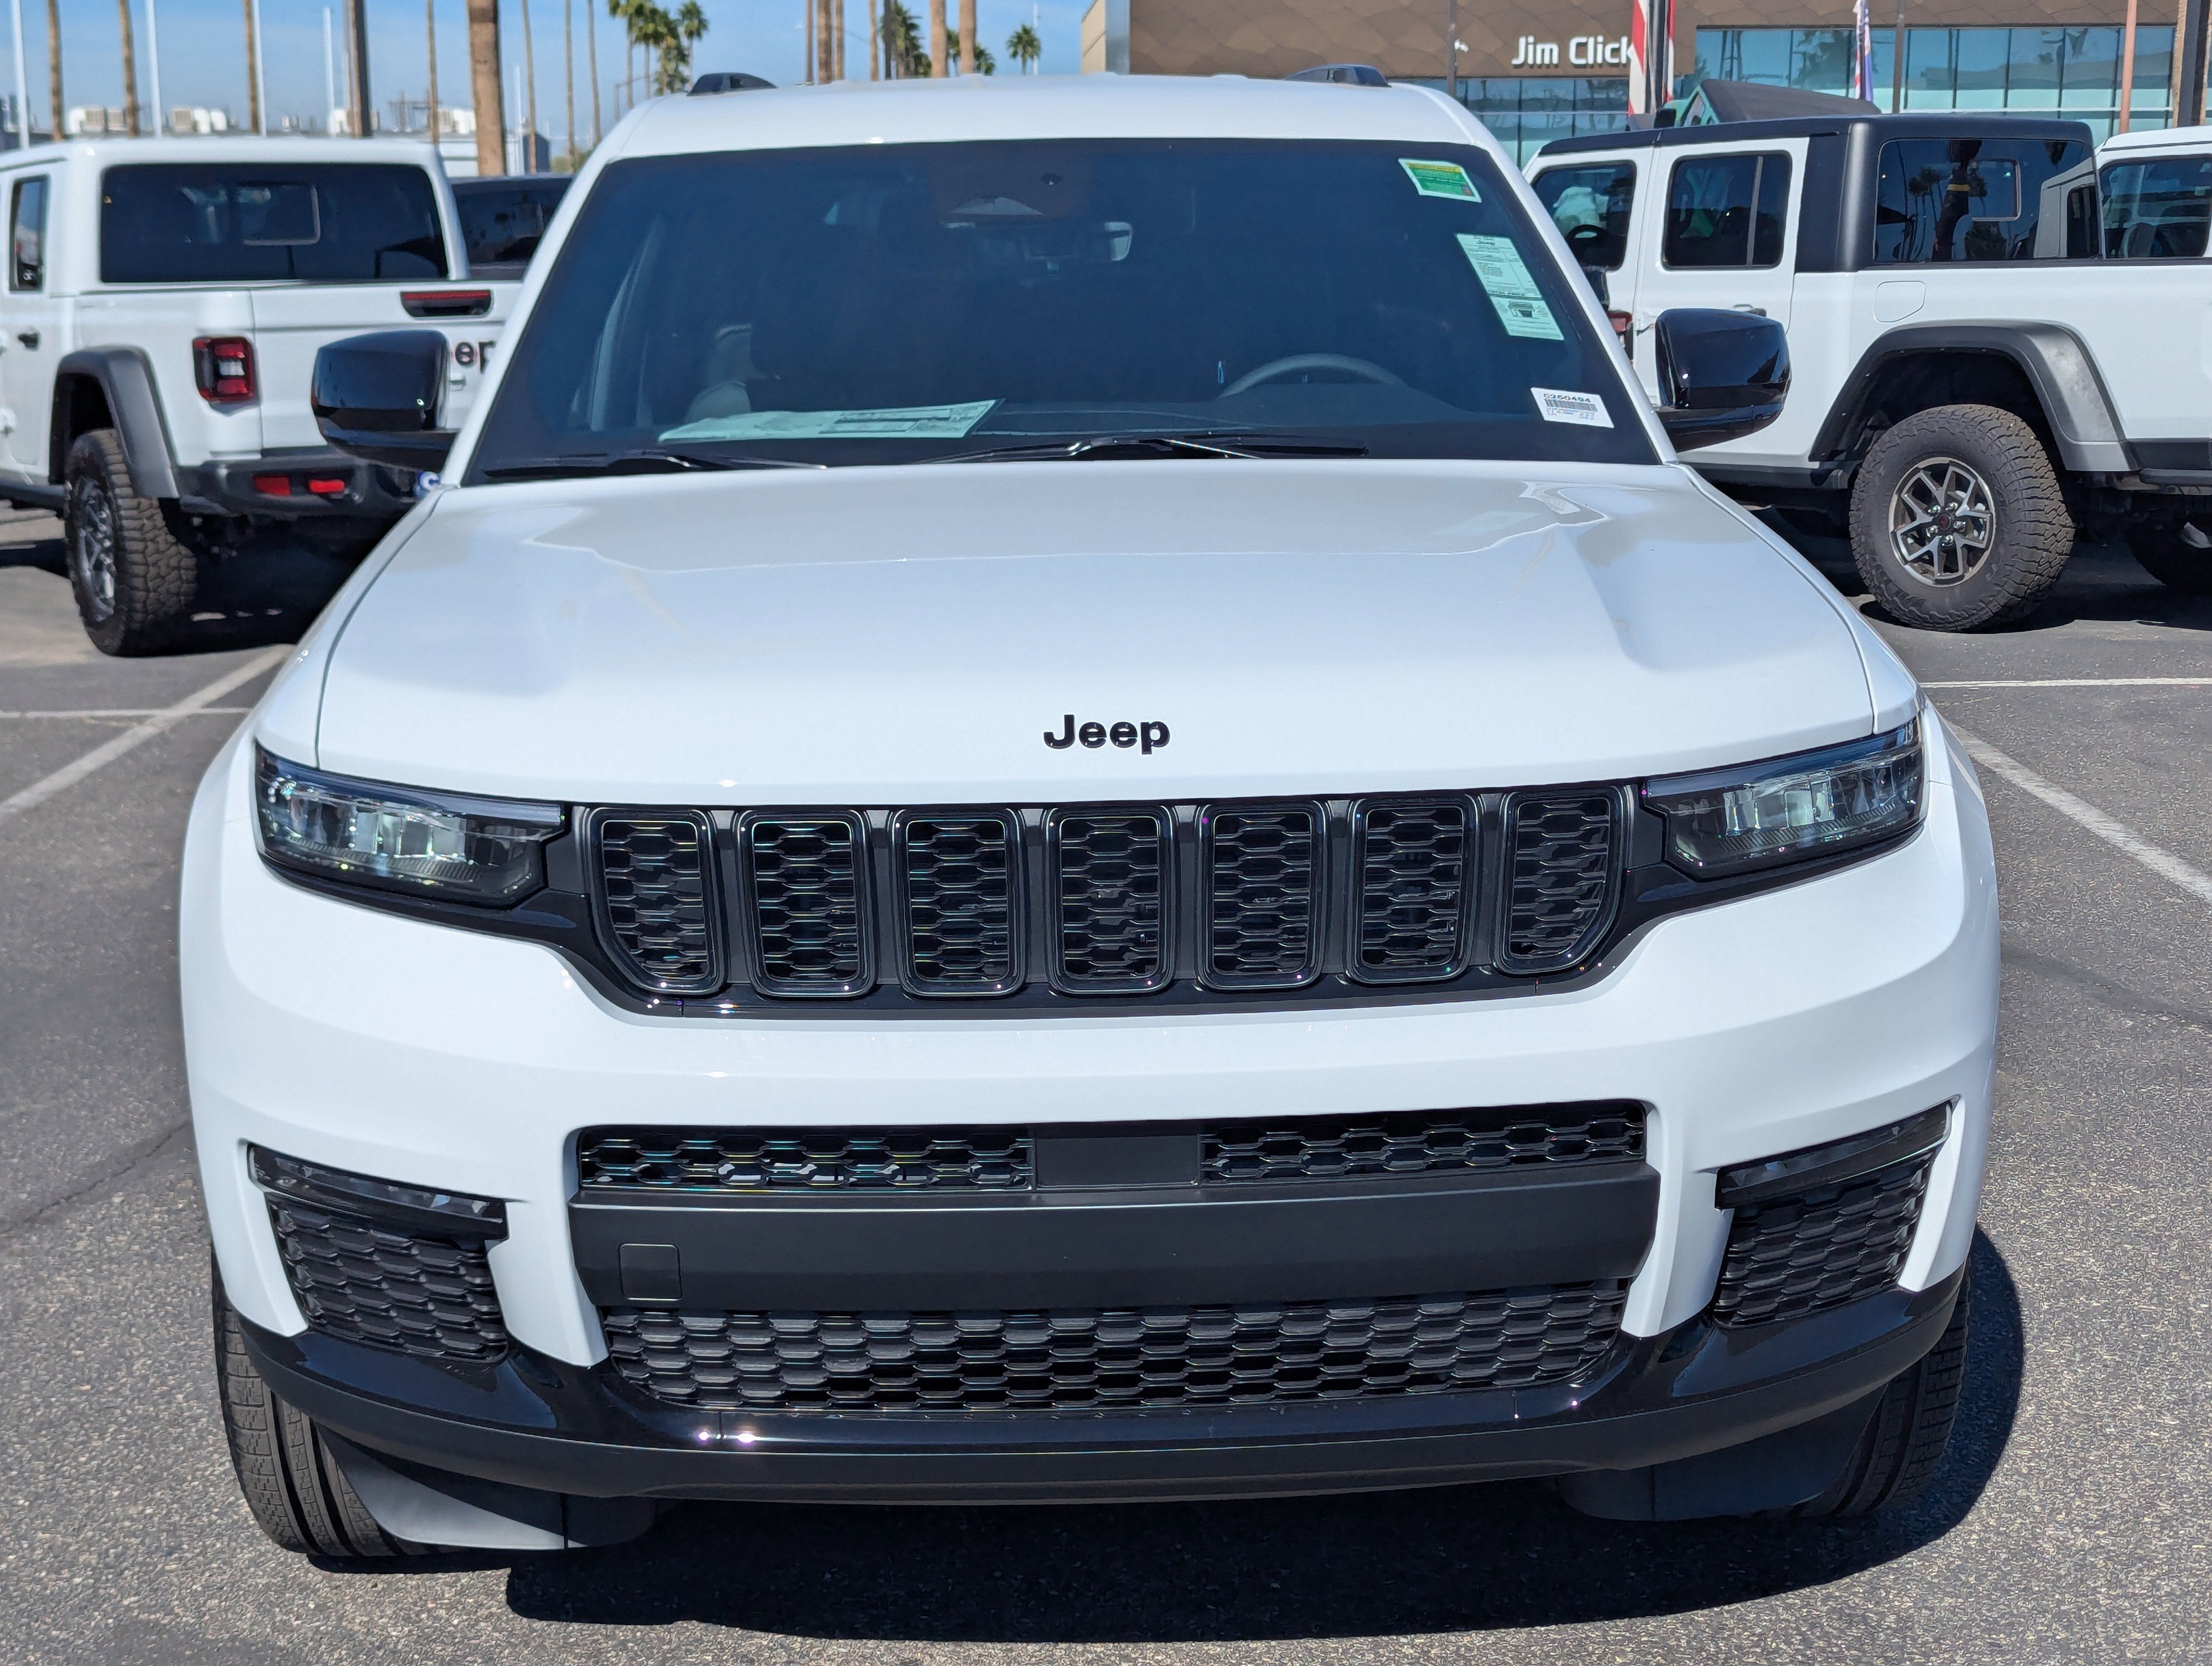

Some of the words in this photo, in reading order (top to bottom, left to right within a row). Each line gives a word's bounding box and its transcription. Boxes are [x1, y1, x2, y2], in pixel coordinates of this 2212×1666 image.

[1511, 35, 1559, 65] Jim
[1569, 35, 1631, 65] Click
[455, 341, 497, 374] ep
[1043, 714, 1171, 755] Jeep
